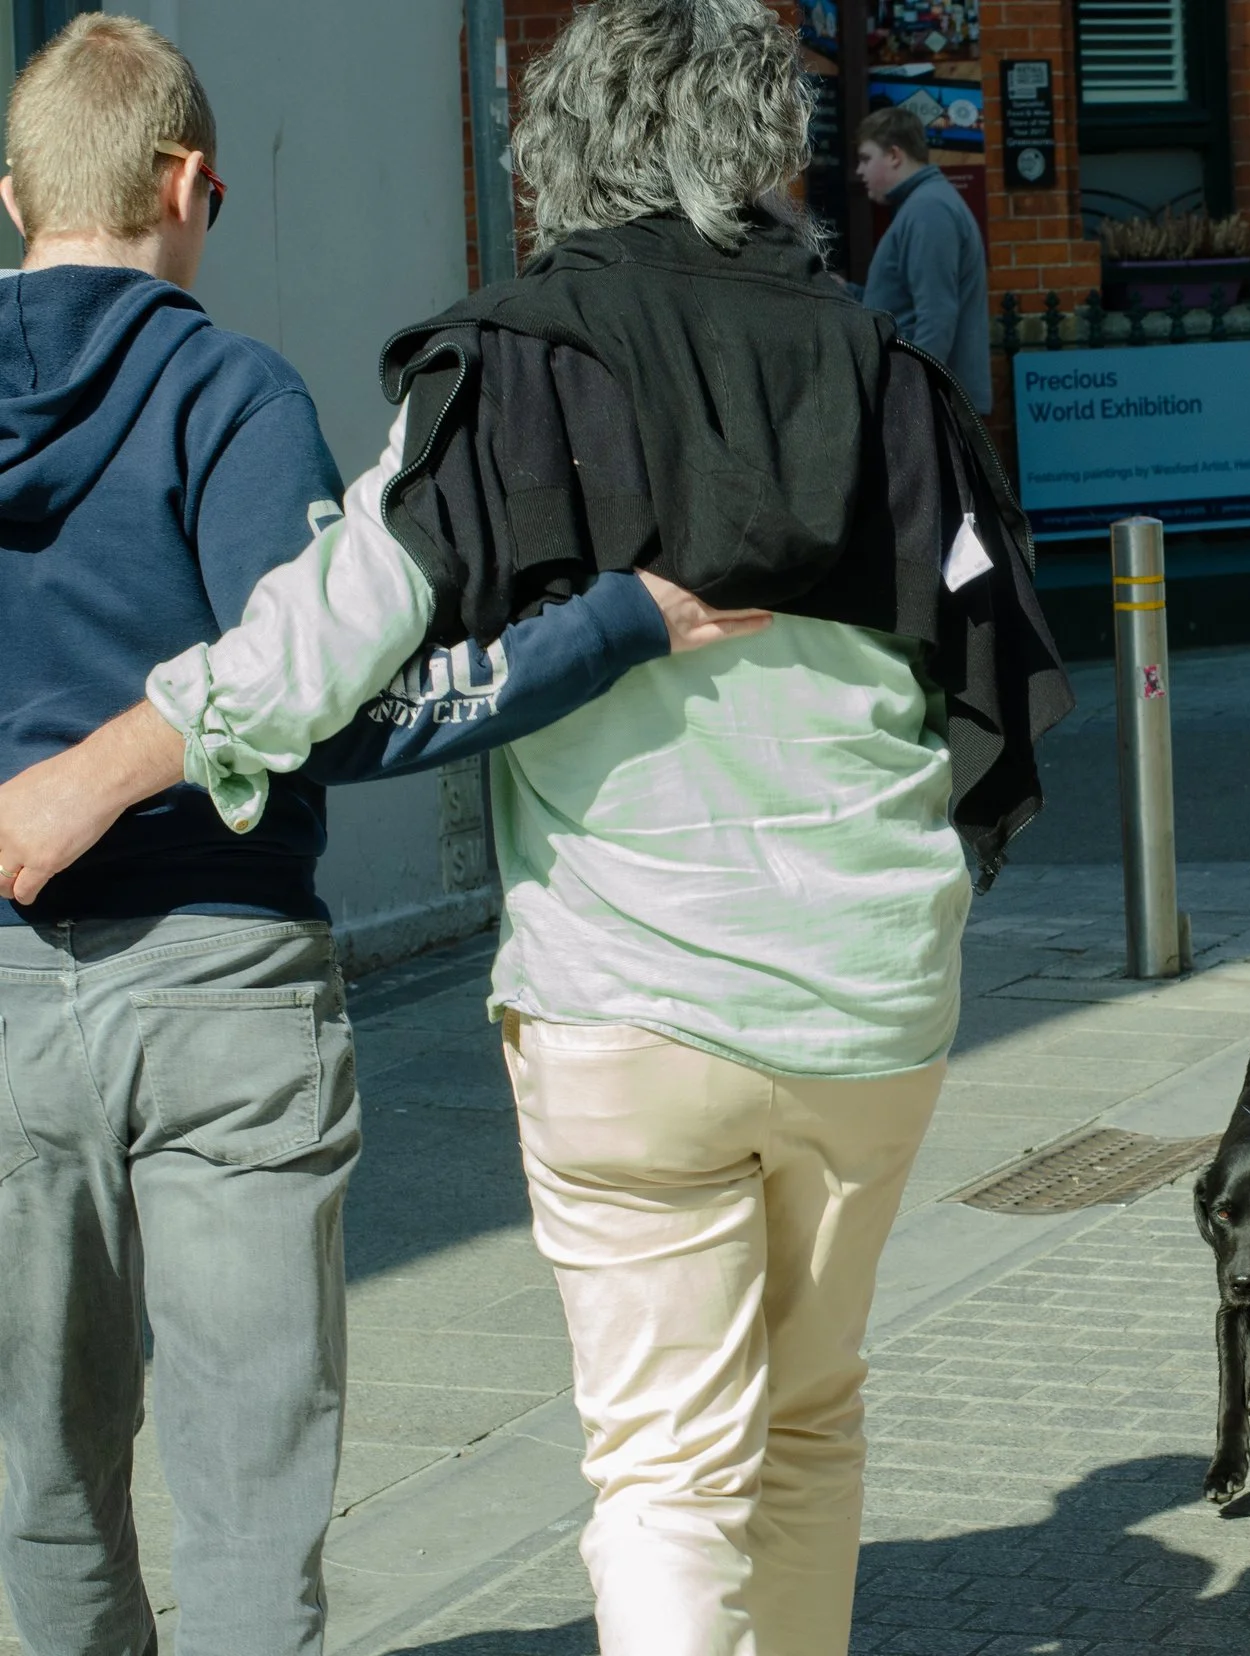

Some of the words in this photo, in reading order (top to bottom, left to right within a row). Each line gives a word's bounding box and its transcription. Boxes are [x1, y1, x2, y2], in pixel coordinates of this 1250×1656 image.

[1025, 368, 1118, 392] Precious
[1028, 398, 1095, 424] World
[1100, 394, 1203, 419] Exhibition
[1082, 466, 1134, 483] paintings
[1135, 465, 1149, 481] by
[433, 690, 502, 724] CITY
